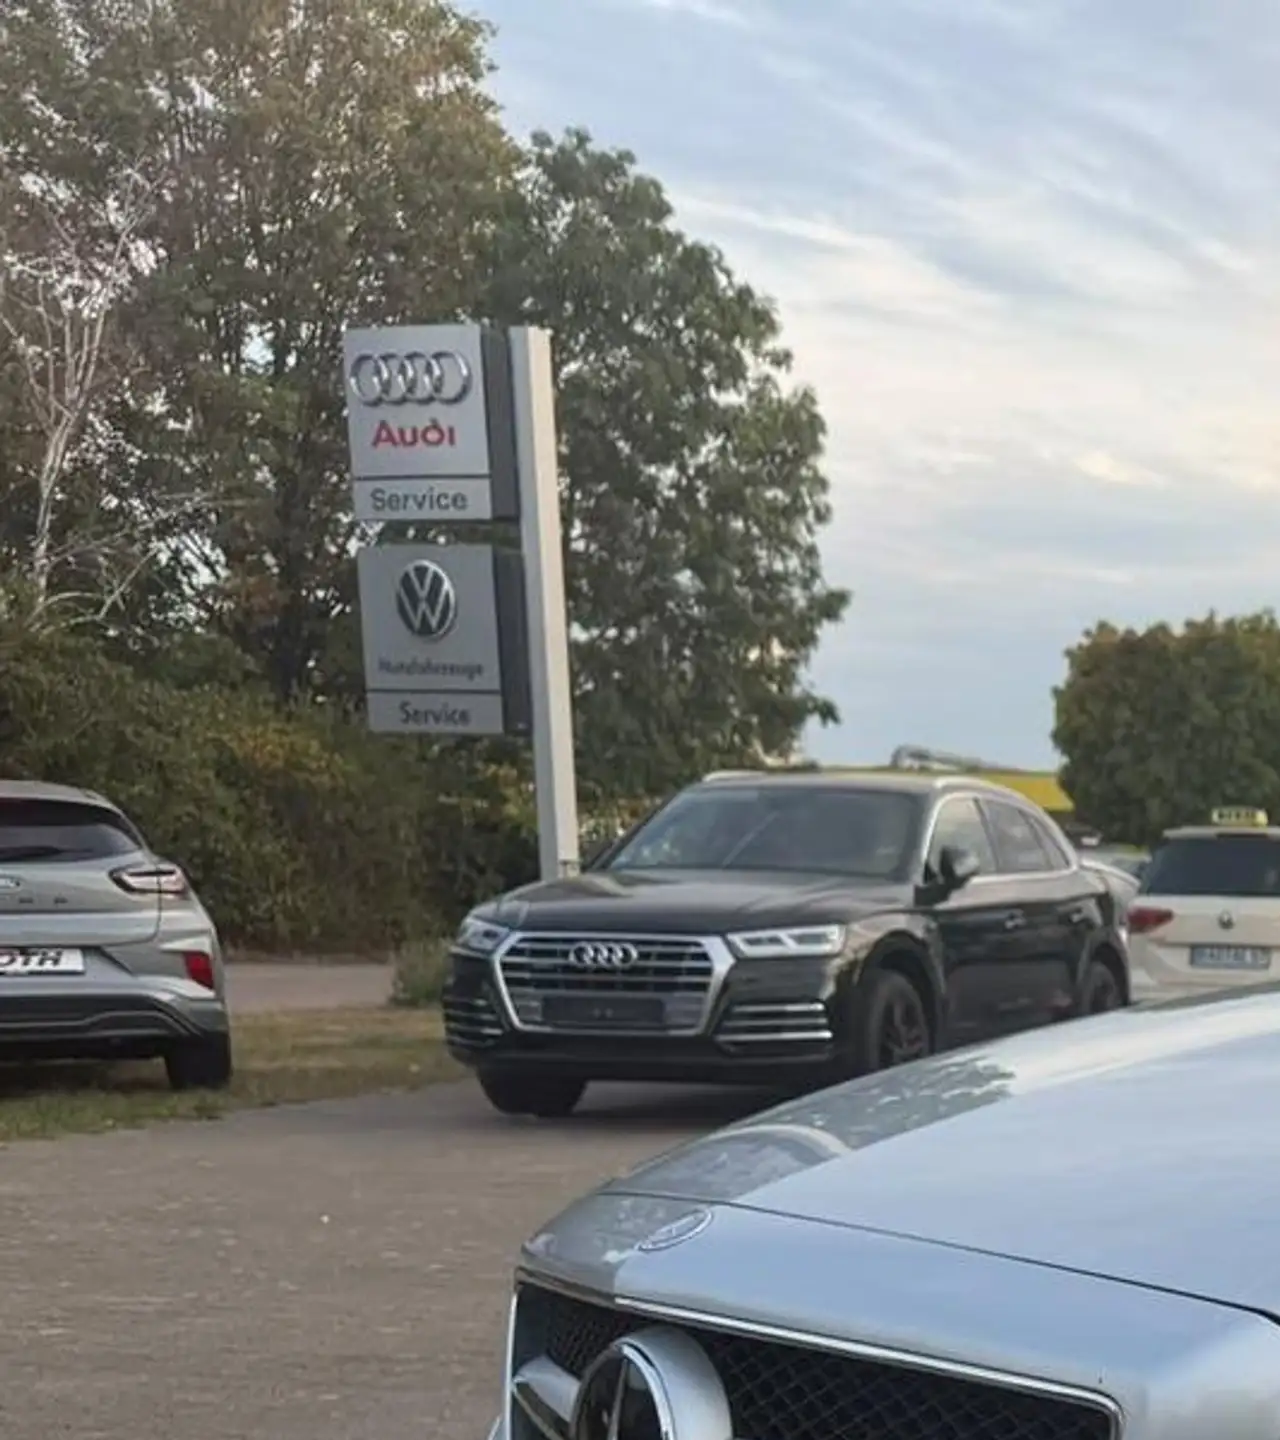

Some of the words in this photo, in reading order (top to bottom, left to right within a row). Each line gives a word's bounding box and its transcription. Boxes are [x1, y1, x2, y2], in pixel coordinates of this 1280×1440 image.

[371, 417, 456, 448] Audi
[370, 487, 468, 512] Service
[399, 700, 471, 727] Service
